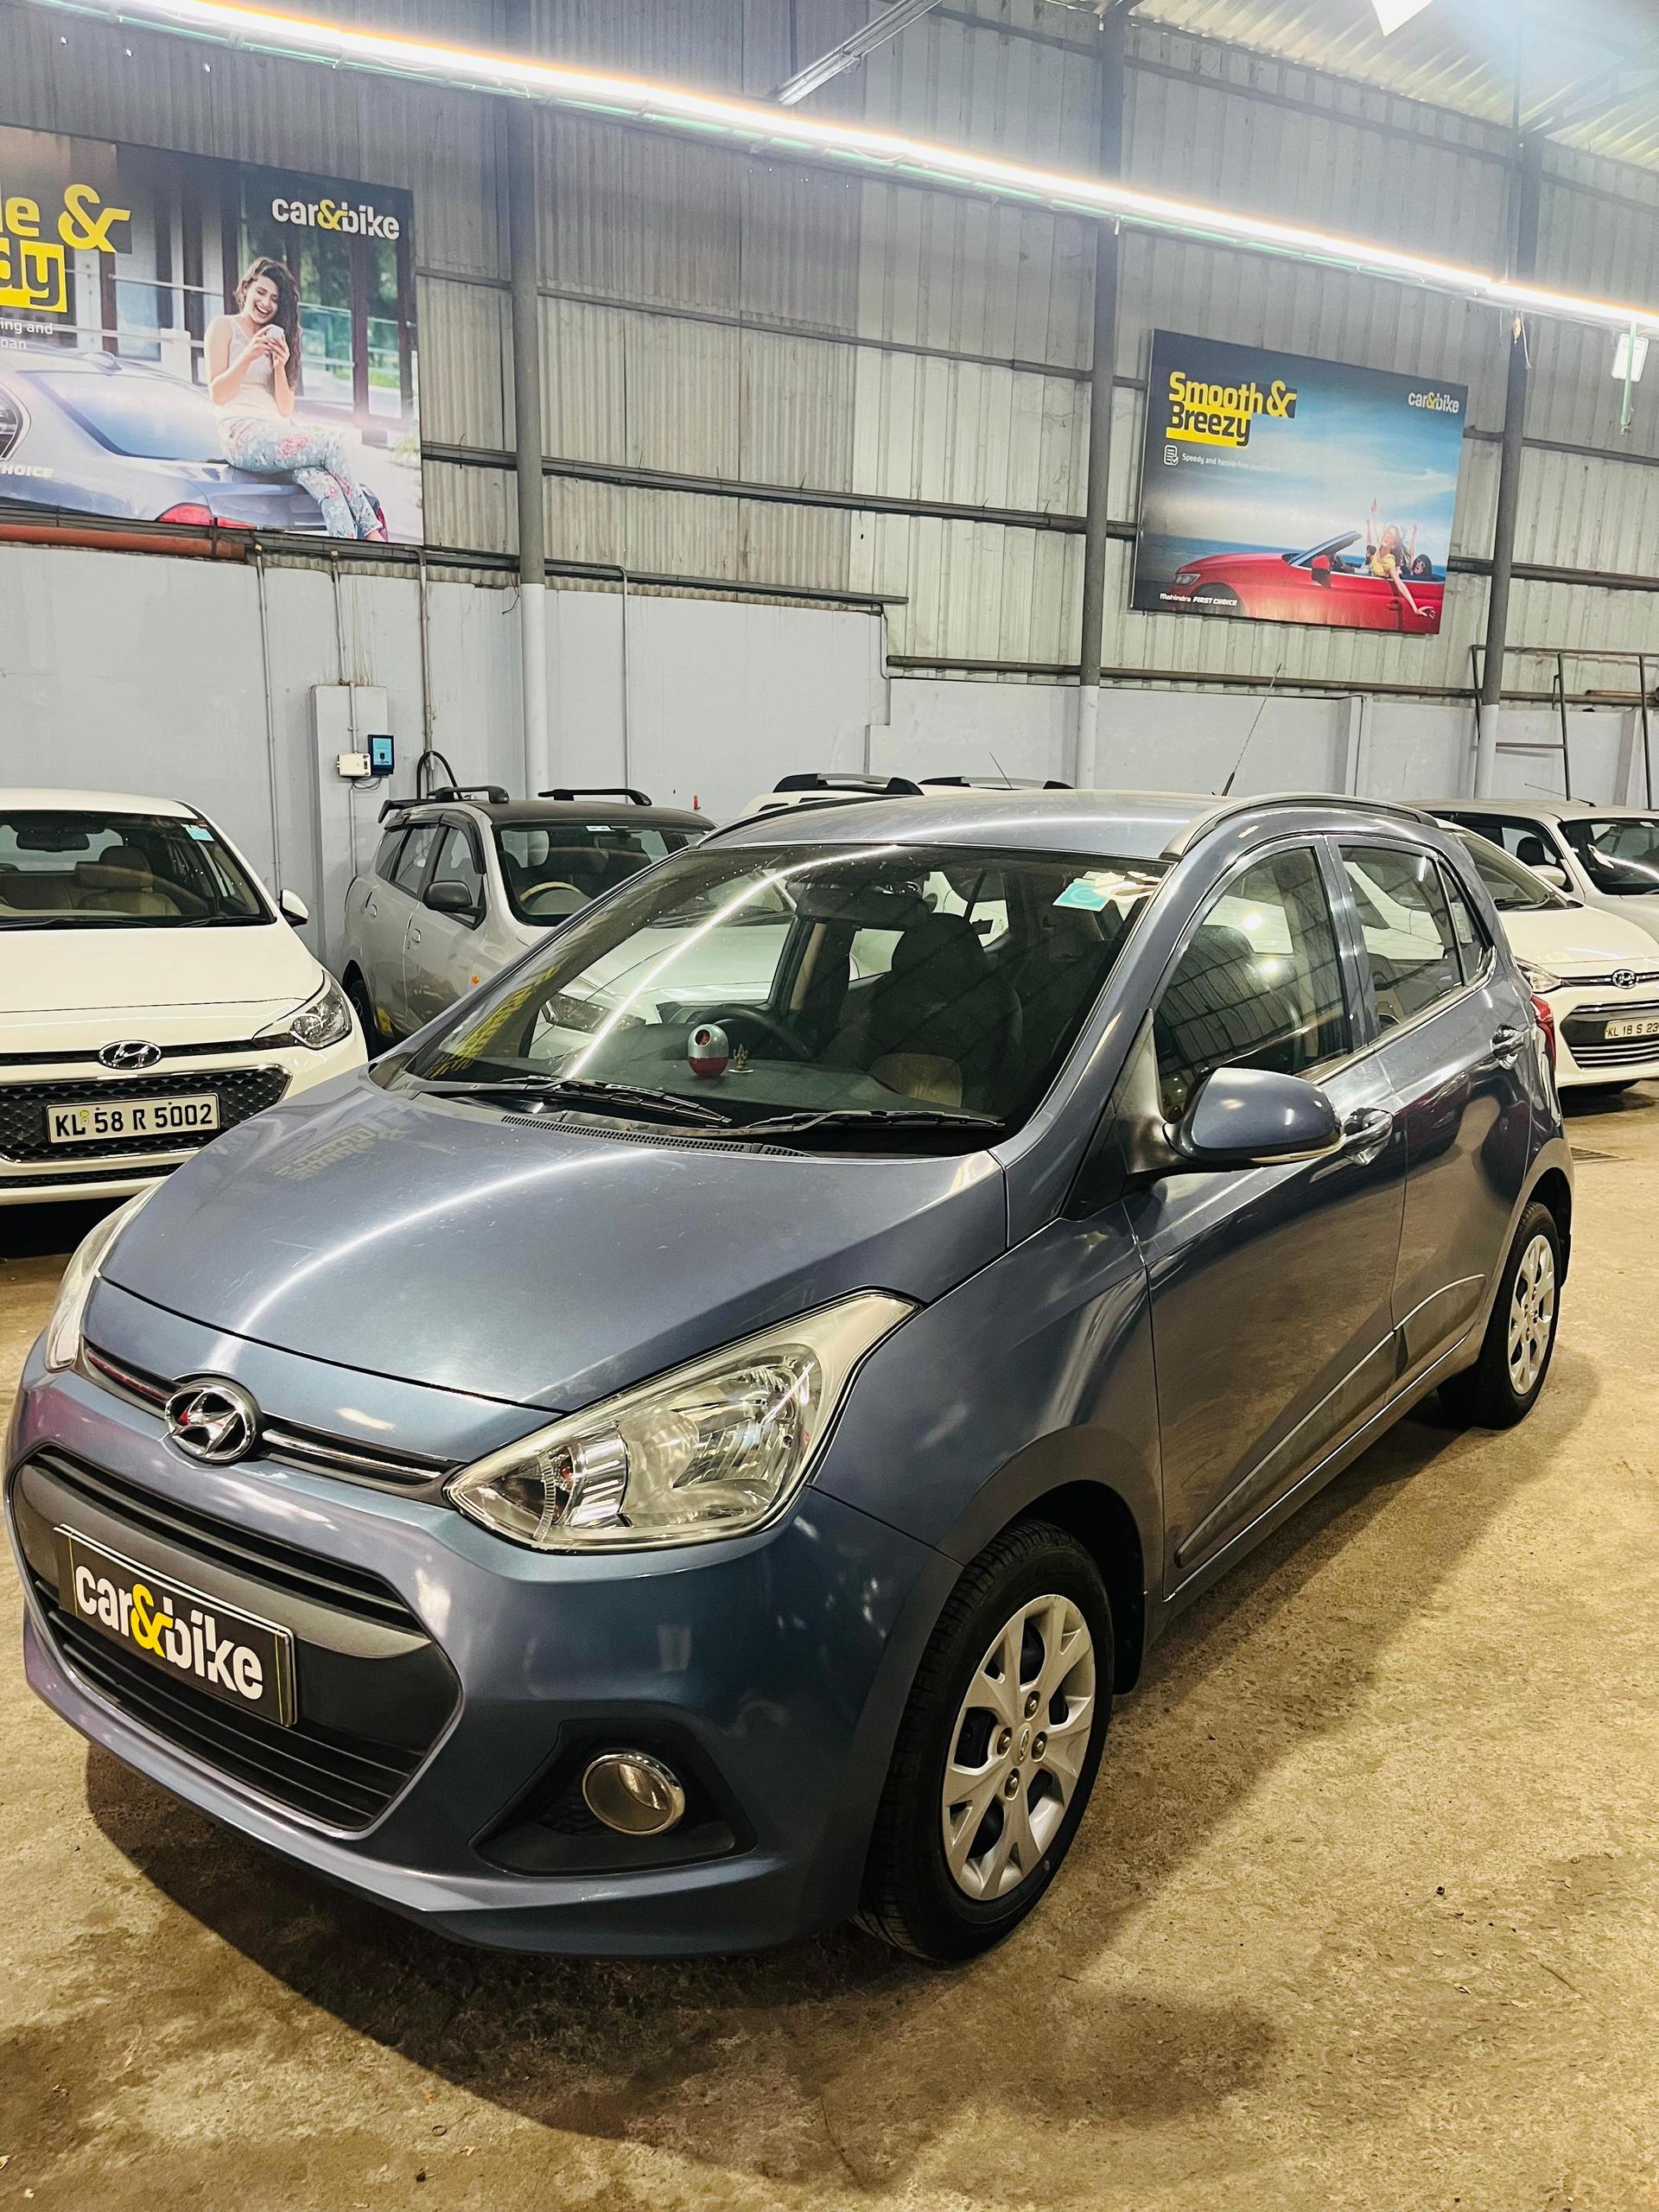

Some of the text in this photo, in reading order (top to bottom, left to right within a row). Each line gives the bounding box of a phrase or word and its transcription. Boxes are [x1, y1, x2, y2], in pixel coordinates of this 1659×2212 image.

[0, 181, 130, 253] e &
[272, 199, 400, 240] car&bike
[27, 322, 53, 335] and
[1168, 371, 1297, 418] Smooth &
[1408, 391, 1459, 413] car&bike
[1168, 400, 1250, 446] Breezy
[0, 463, 54, 478] HOICE
[1182, 453, 1205, 465] Speedy
[1205, 456, 1217, 465] and
[1160, 594, 1191, 602] Mahindra
[1608, 1023, 1659, 1036] KL 18 S 23
[55, 1103, 213, 1137] KL 58 R 5002
[76, 1566, 263, 1700] car&bike
